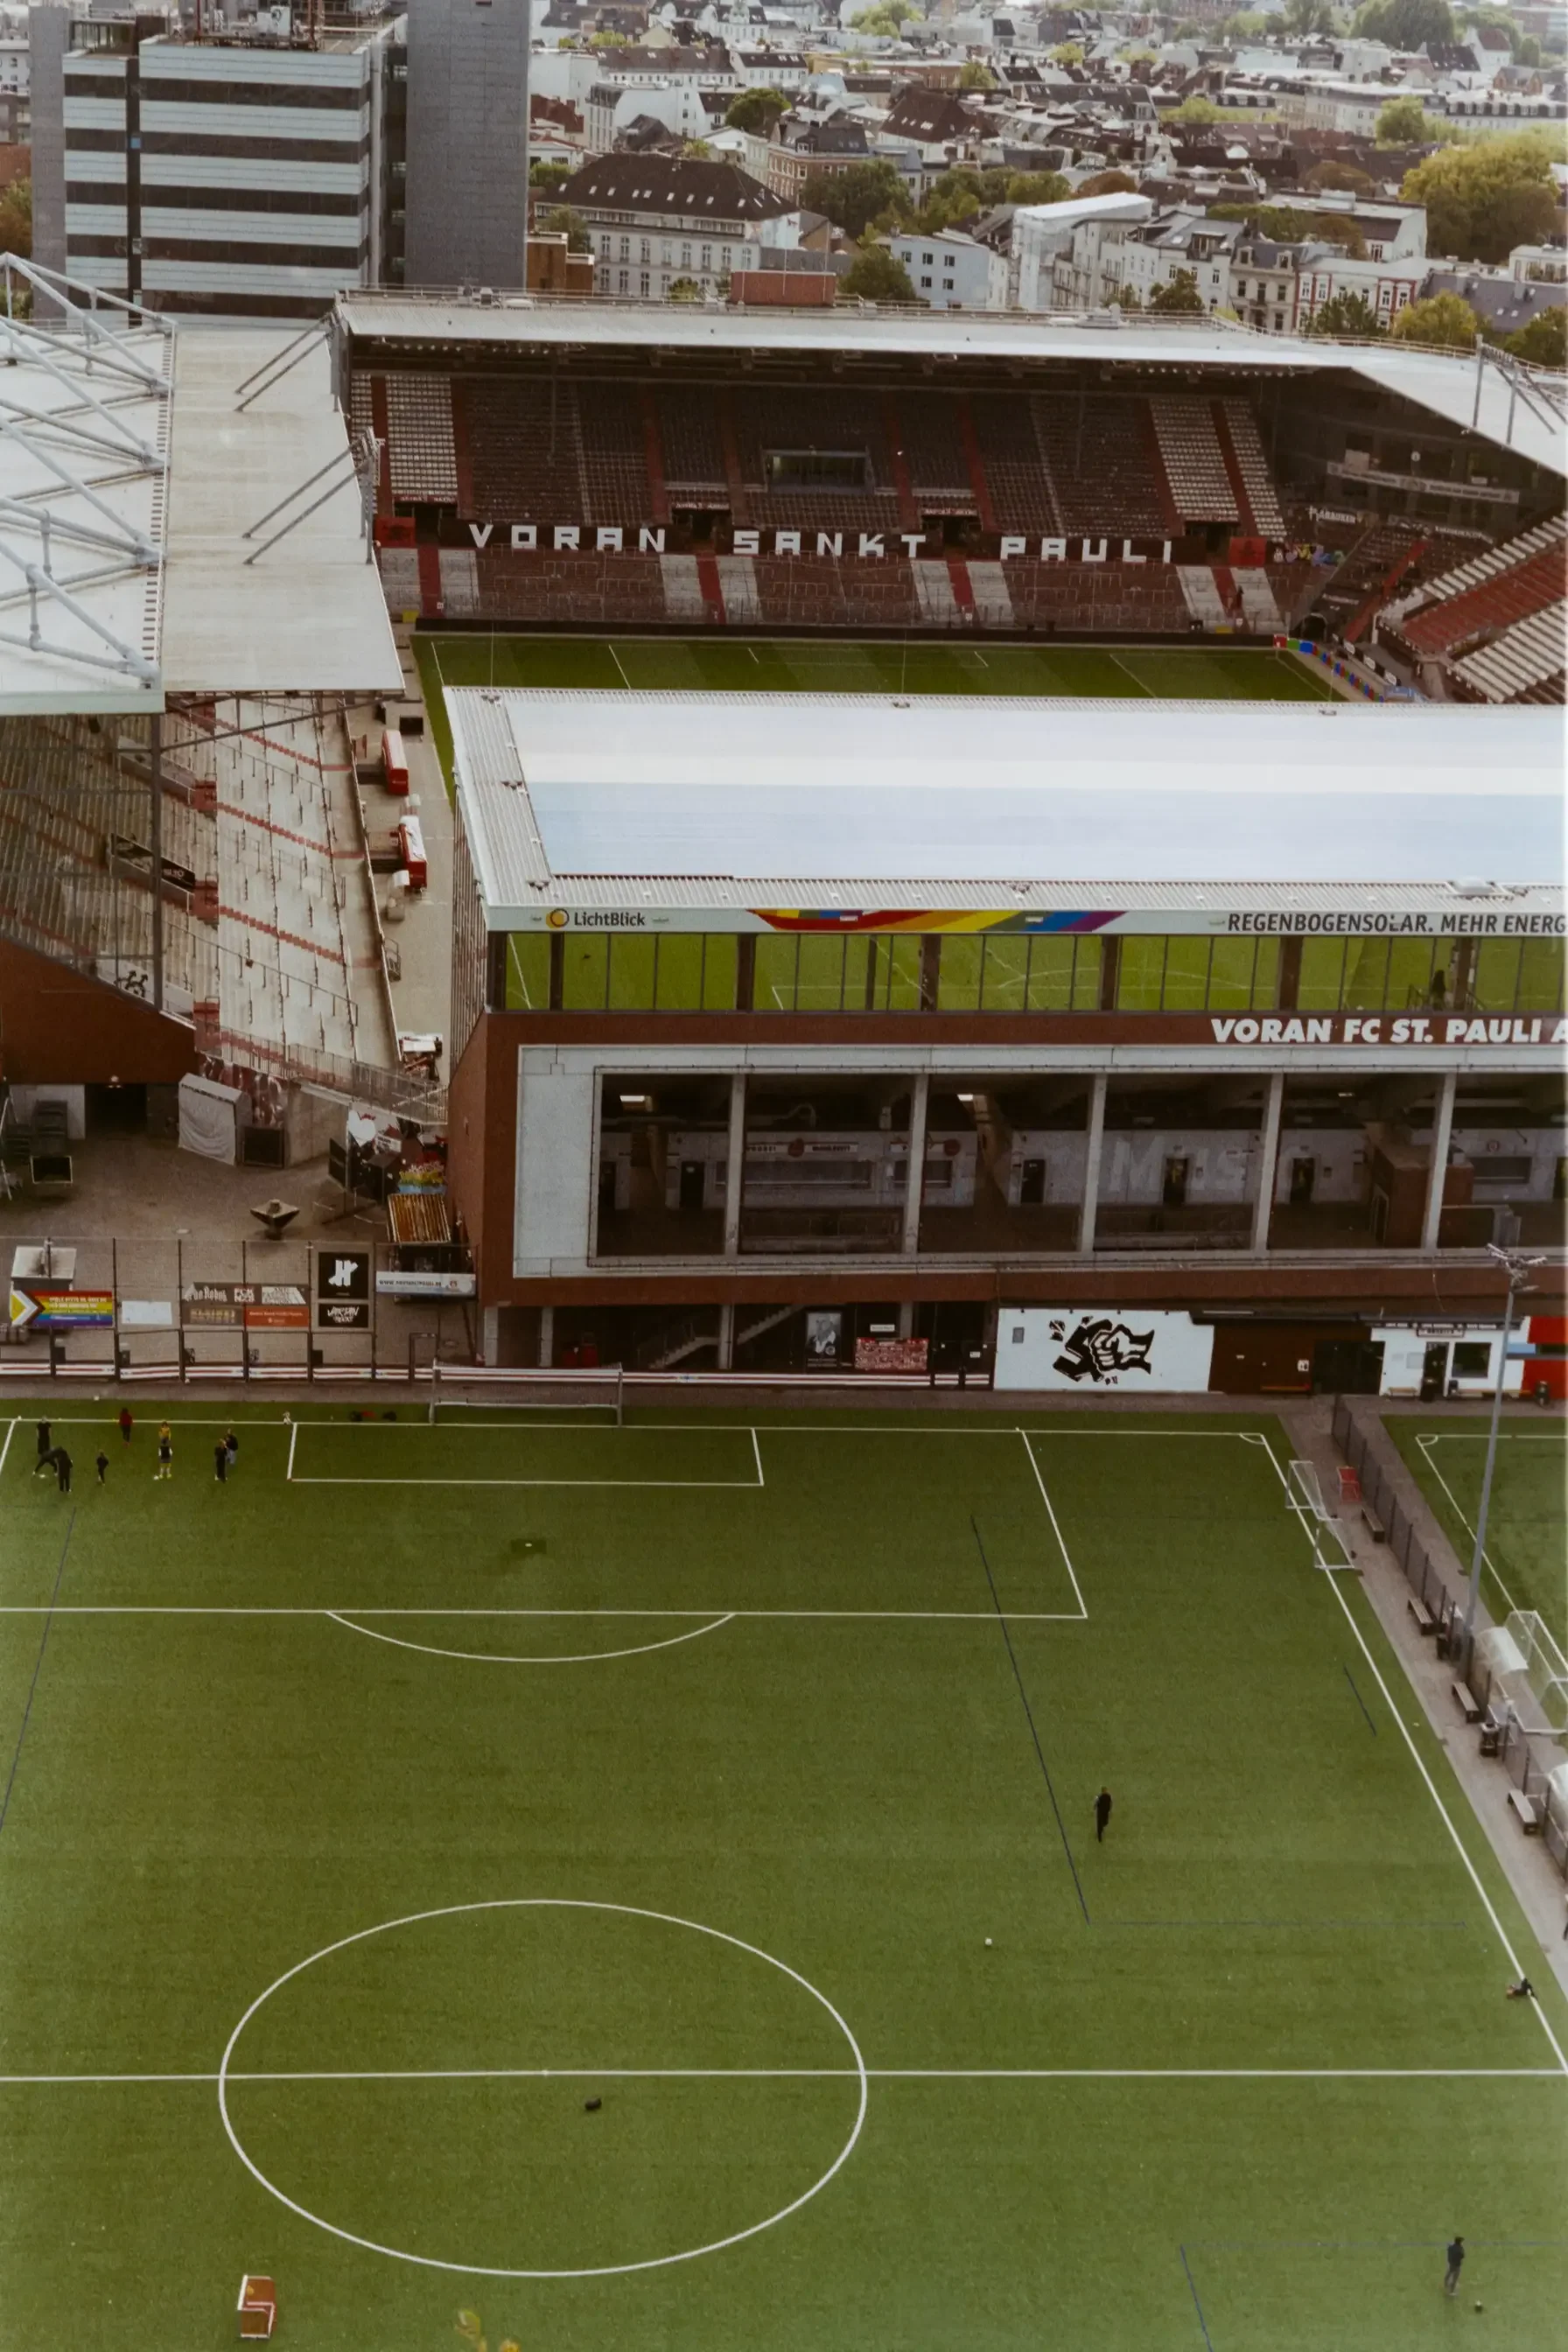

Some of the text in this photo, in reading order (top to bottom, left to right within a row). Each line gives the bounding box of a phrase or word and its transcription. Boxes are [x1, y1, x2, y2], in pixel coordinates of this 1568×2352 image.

[469, 524, 1172, 563] VORAN SANKT PAULI
[574, 912, 646, 927] LichtBlick
[1441, 914, 1497, 933] MEHR
[1211, 1018, 1331, 1043] VORAN
[1343, 1018, 1380, 1043] FC
[1390, 1018, 1433, 1043] ST.
[1446, 1018, 1542, 1043] PAULI
